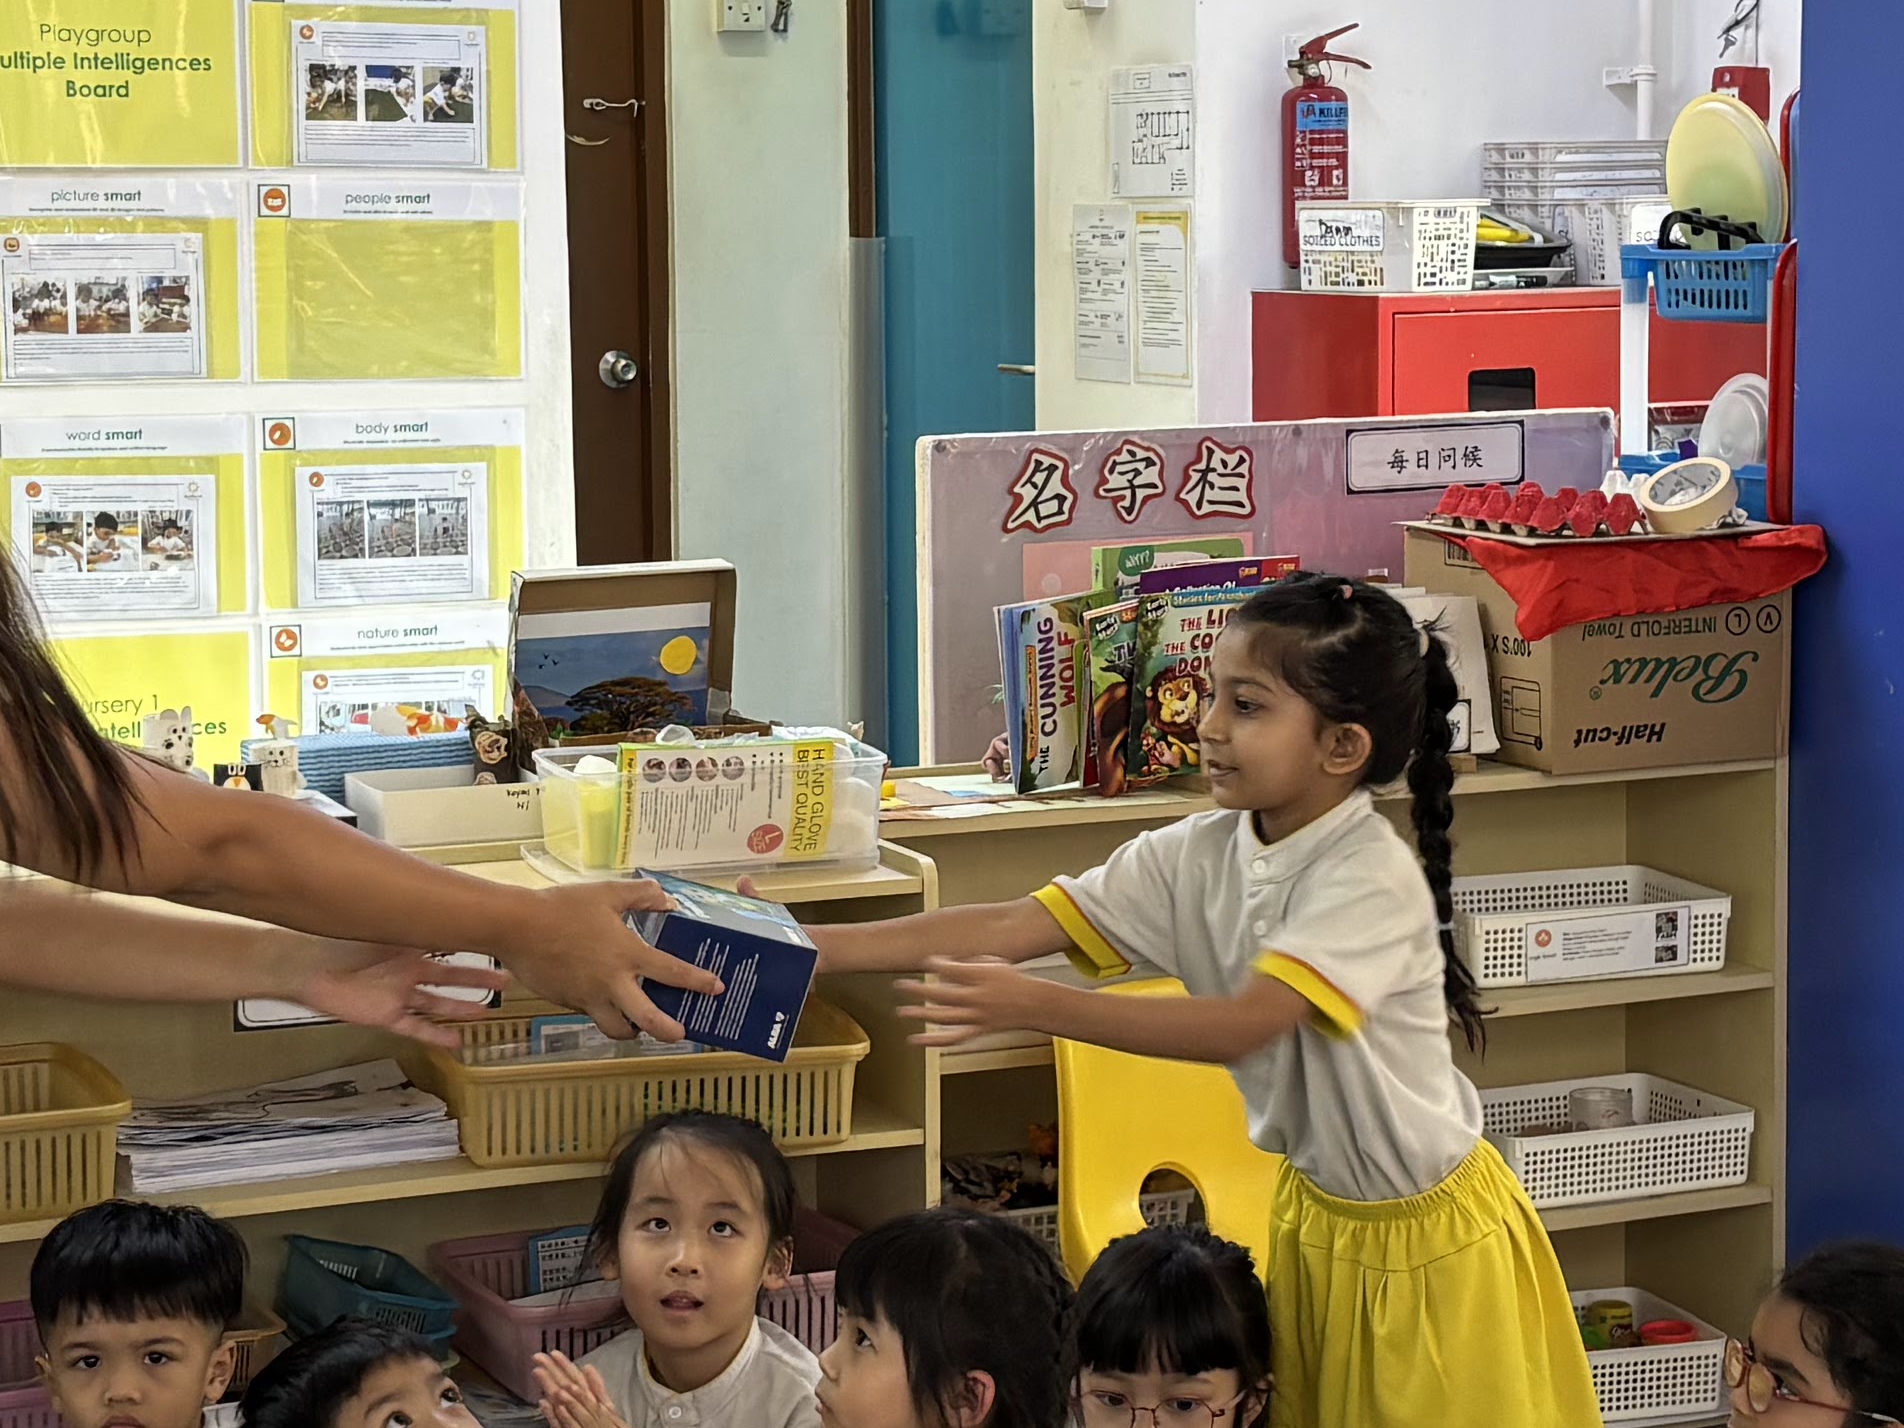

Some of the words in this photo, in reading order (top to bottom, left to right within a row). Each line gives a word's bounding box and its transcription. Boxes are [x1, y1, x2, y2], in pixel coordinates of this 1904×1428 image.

[39, 23, 152, 47] Playgroup
[73, 52, 212, 75] Intelligences
[65, 80, 130, 98] Board
[51, 190, 100, 204] picture
[103, 189, 142, 203] smart
[345, 193, 392, 207] people
[395, 192, 431, 205] smart
[1339, 234, 1381, 247] CLOTHES
[65, 428, 101, 441] word
[104, 428, 143, 441] smart
[355, 422, 390, 436] body
[393, 421, 429, 433] smart
[1386, 444, 1485, 475] 每日问候
[1007, 444, 1250, 528] 名字栏
[357, 627, 399, 639] nature
[403, 624, 438, 637] smart
[1180, 616, 1202, 632] THE
[1581, 622, 1626, 641] Towel
[1630, 615, 1717, 638] INTERFOLD
[1164, 642, 1186, 655] THE
[1037, 617, 1058, 737] CUNNING
[1058, 631, 1076, 708] WOLF
[1600, 650, 1760, 704] Belux
[82, 698, 143, 716] ursery
[152, 694, 158, 711] 1
[1573, 721, 1667, 749] Half-cut
[796, 749, 810, 786] BEST
[1038, 745, 1050, 773] THE
[810, 748, 826, 797] HAND
[789, 793, 809, 852] QUALITY
[804, 803, 825, 852] GLOVE
